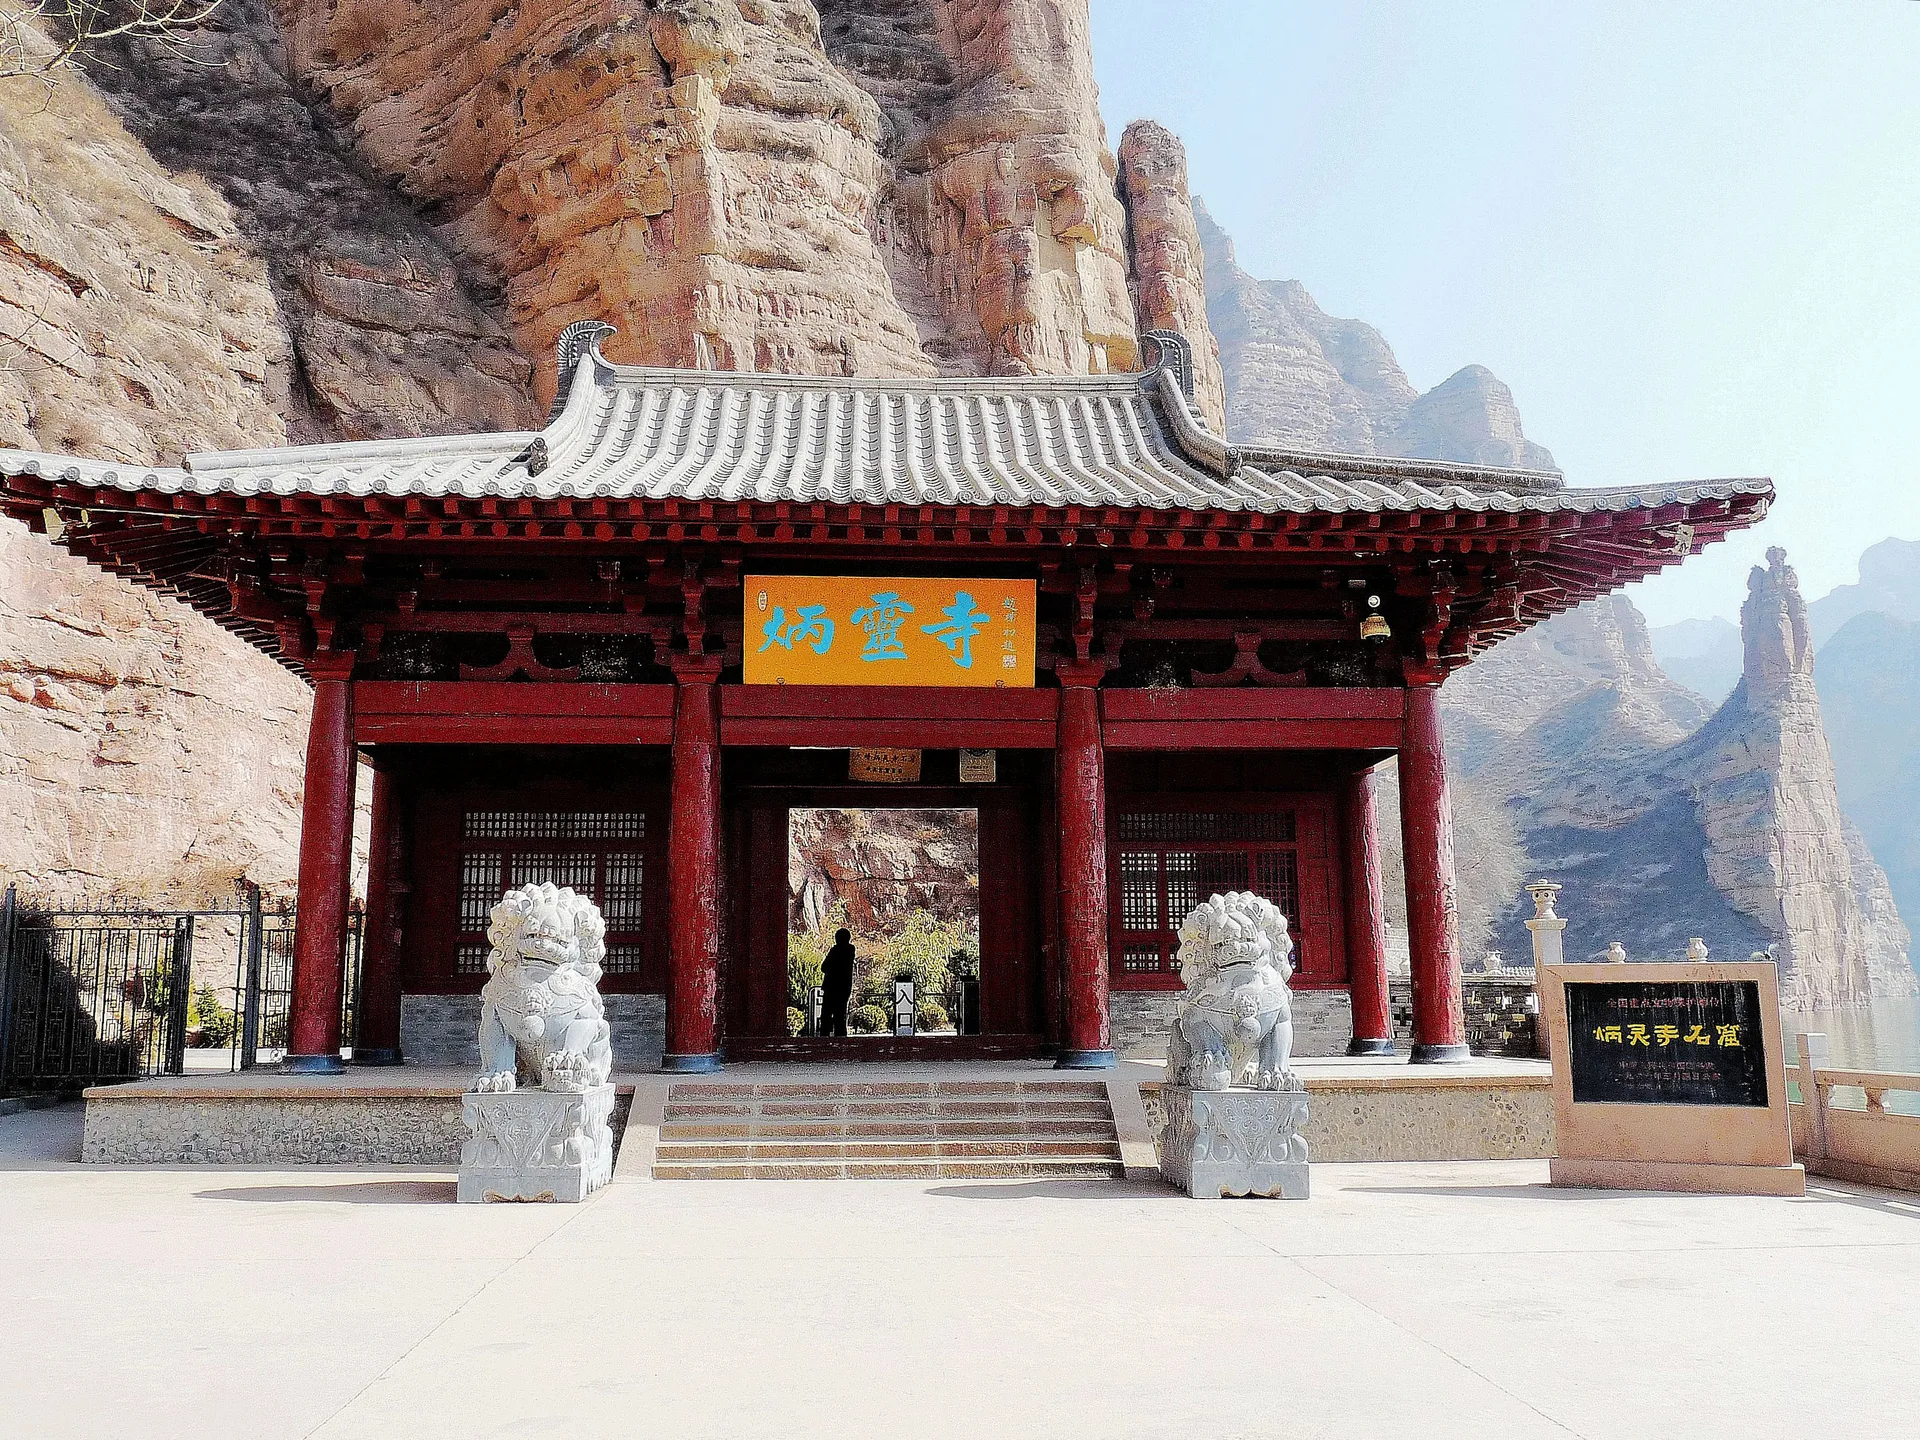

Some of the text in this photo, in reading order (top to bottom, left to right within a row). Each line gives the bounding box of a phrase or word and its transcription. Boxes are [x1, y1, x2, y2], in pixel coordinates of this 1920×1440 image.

[756, 590, 991, 669] 炳靈寺
[896, 989, 913, 1028] 入口
[1592, 1023, 1741, 1047] 炳灵寺石窟
